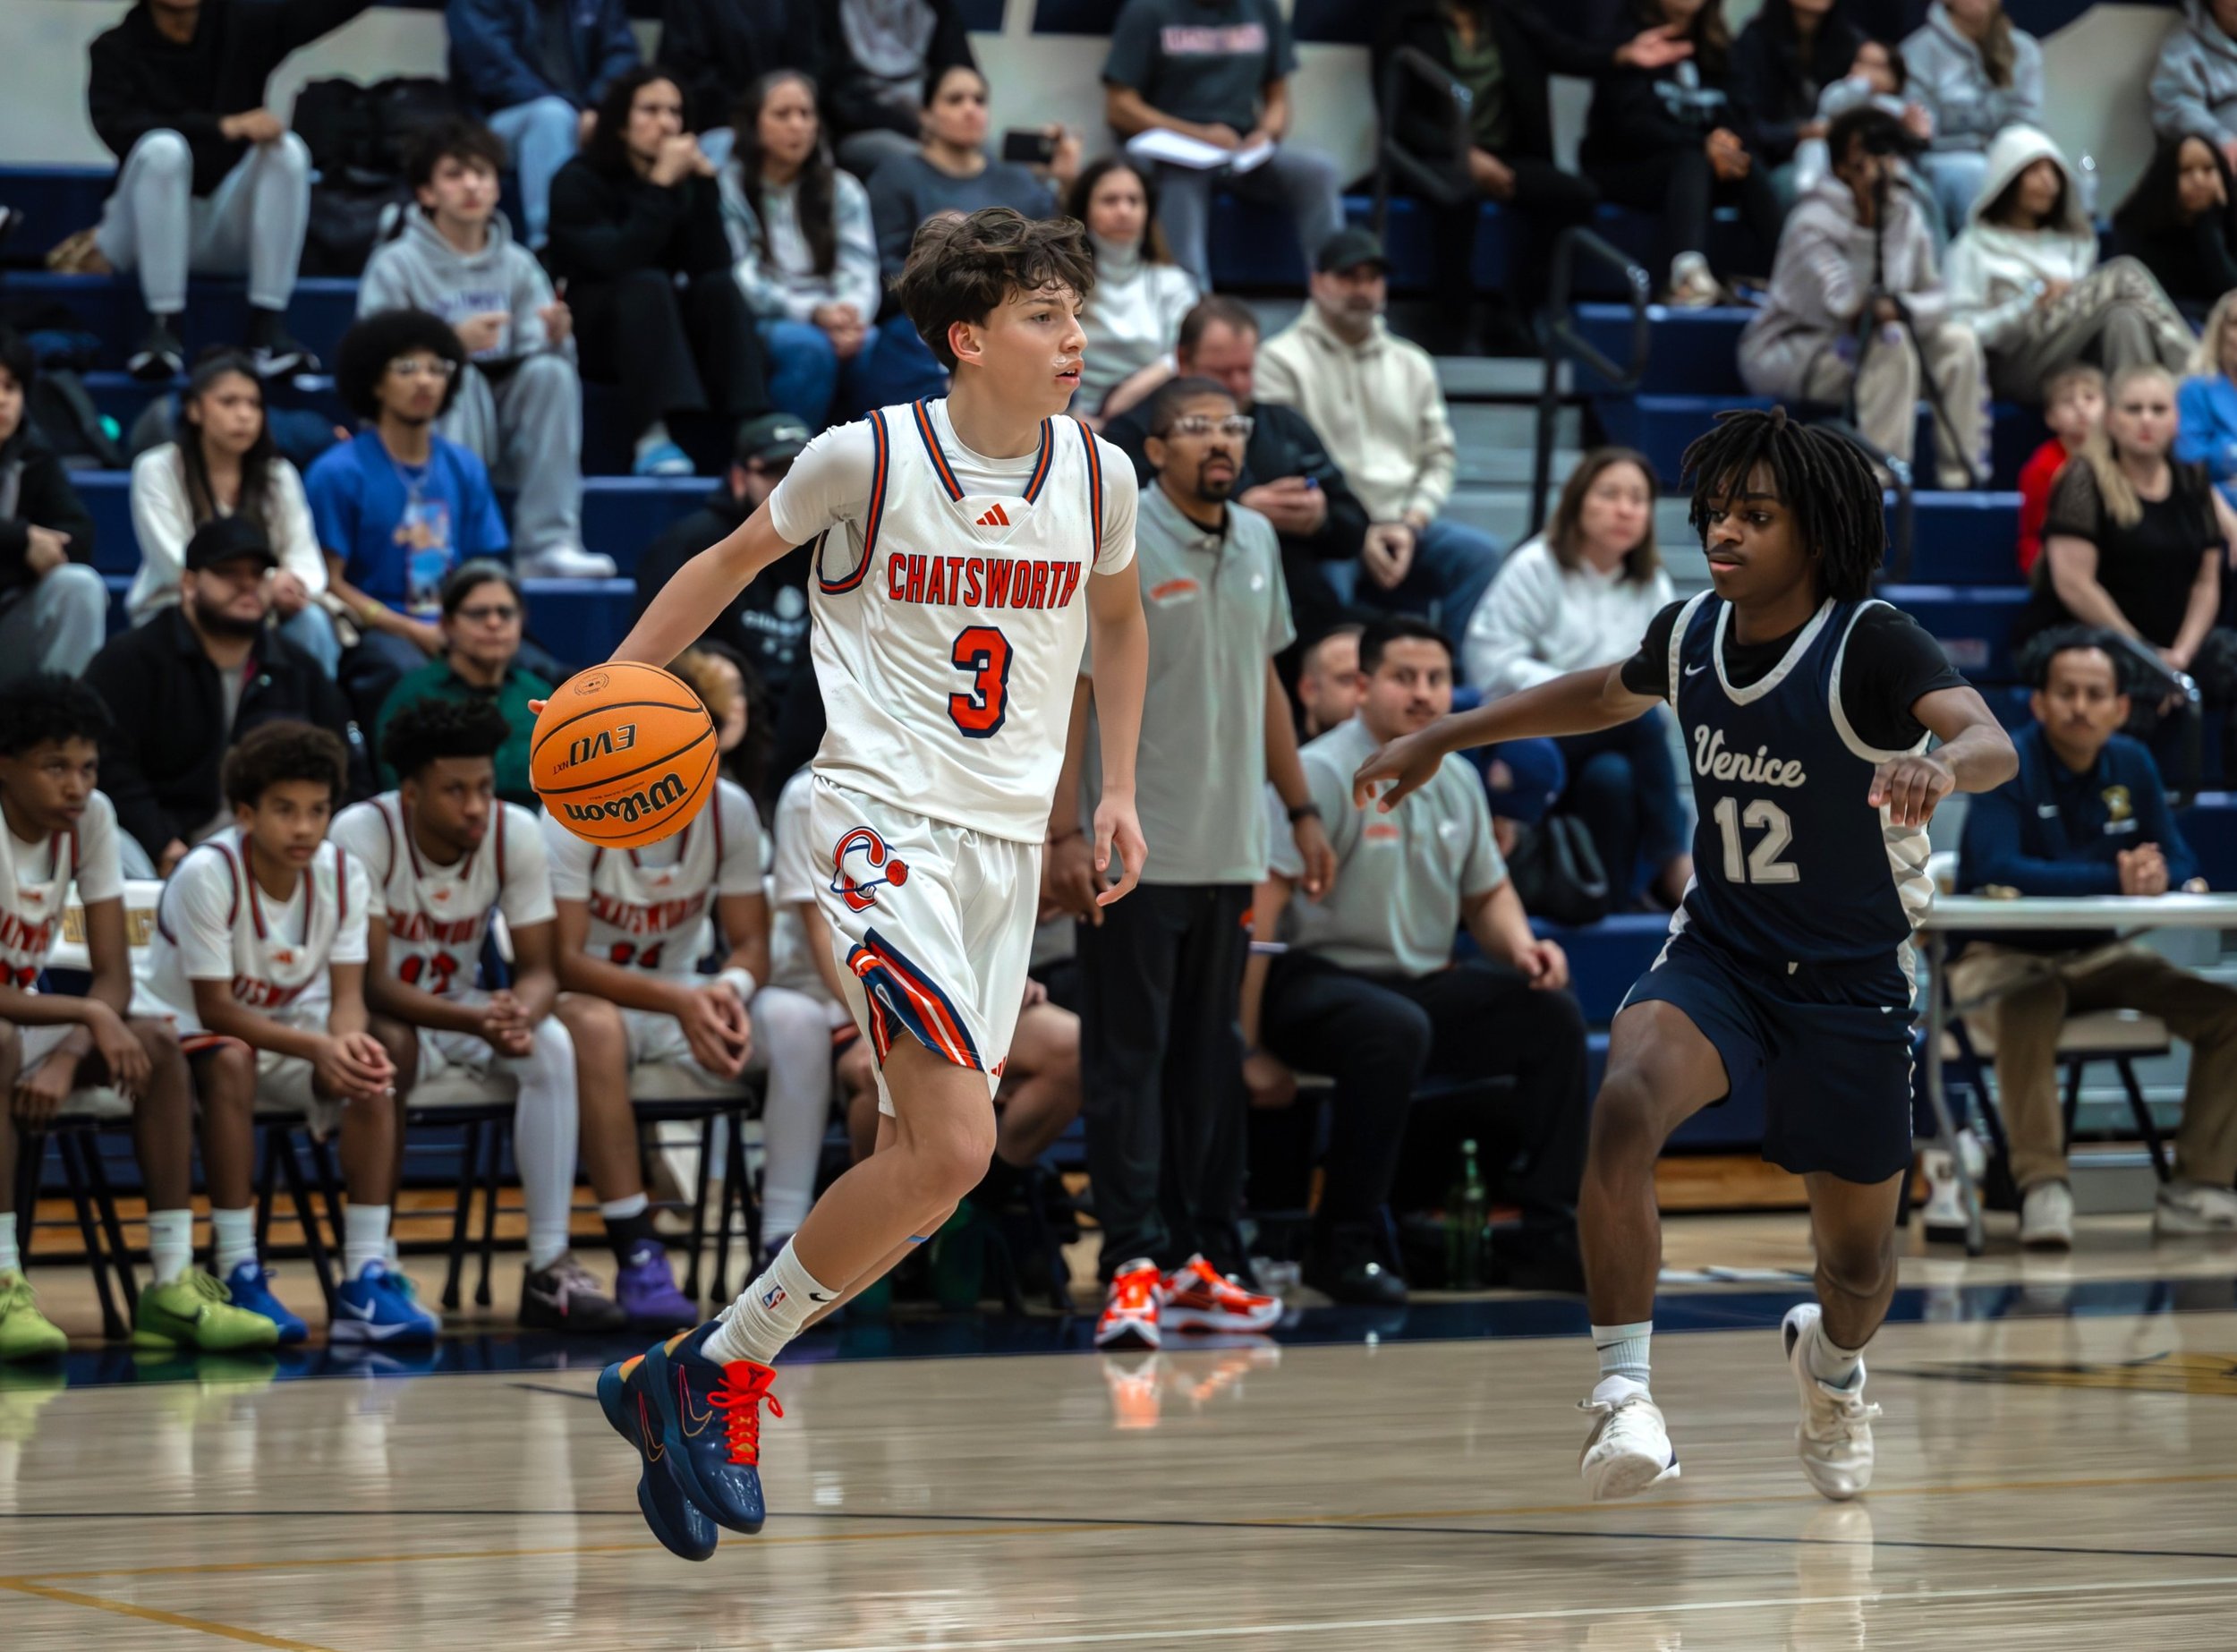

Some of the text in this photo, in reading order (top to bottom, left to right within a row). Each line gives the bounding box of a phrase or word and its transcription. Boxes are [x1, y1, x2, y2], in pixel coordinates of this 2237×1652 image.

[888, 552, 1081, 609] CHATSWORTH
[948, 626, 1014, 738] 3
[552, 722, 637, 776] EVO NXT
[1694, 724, 1807, 788] Venice
[563, 772, 688, 822] Wilson
[1714, 796, 1800, 884] 12
